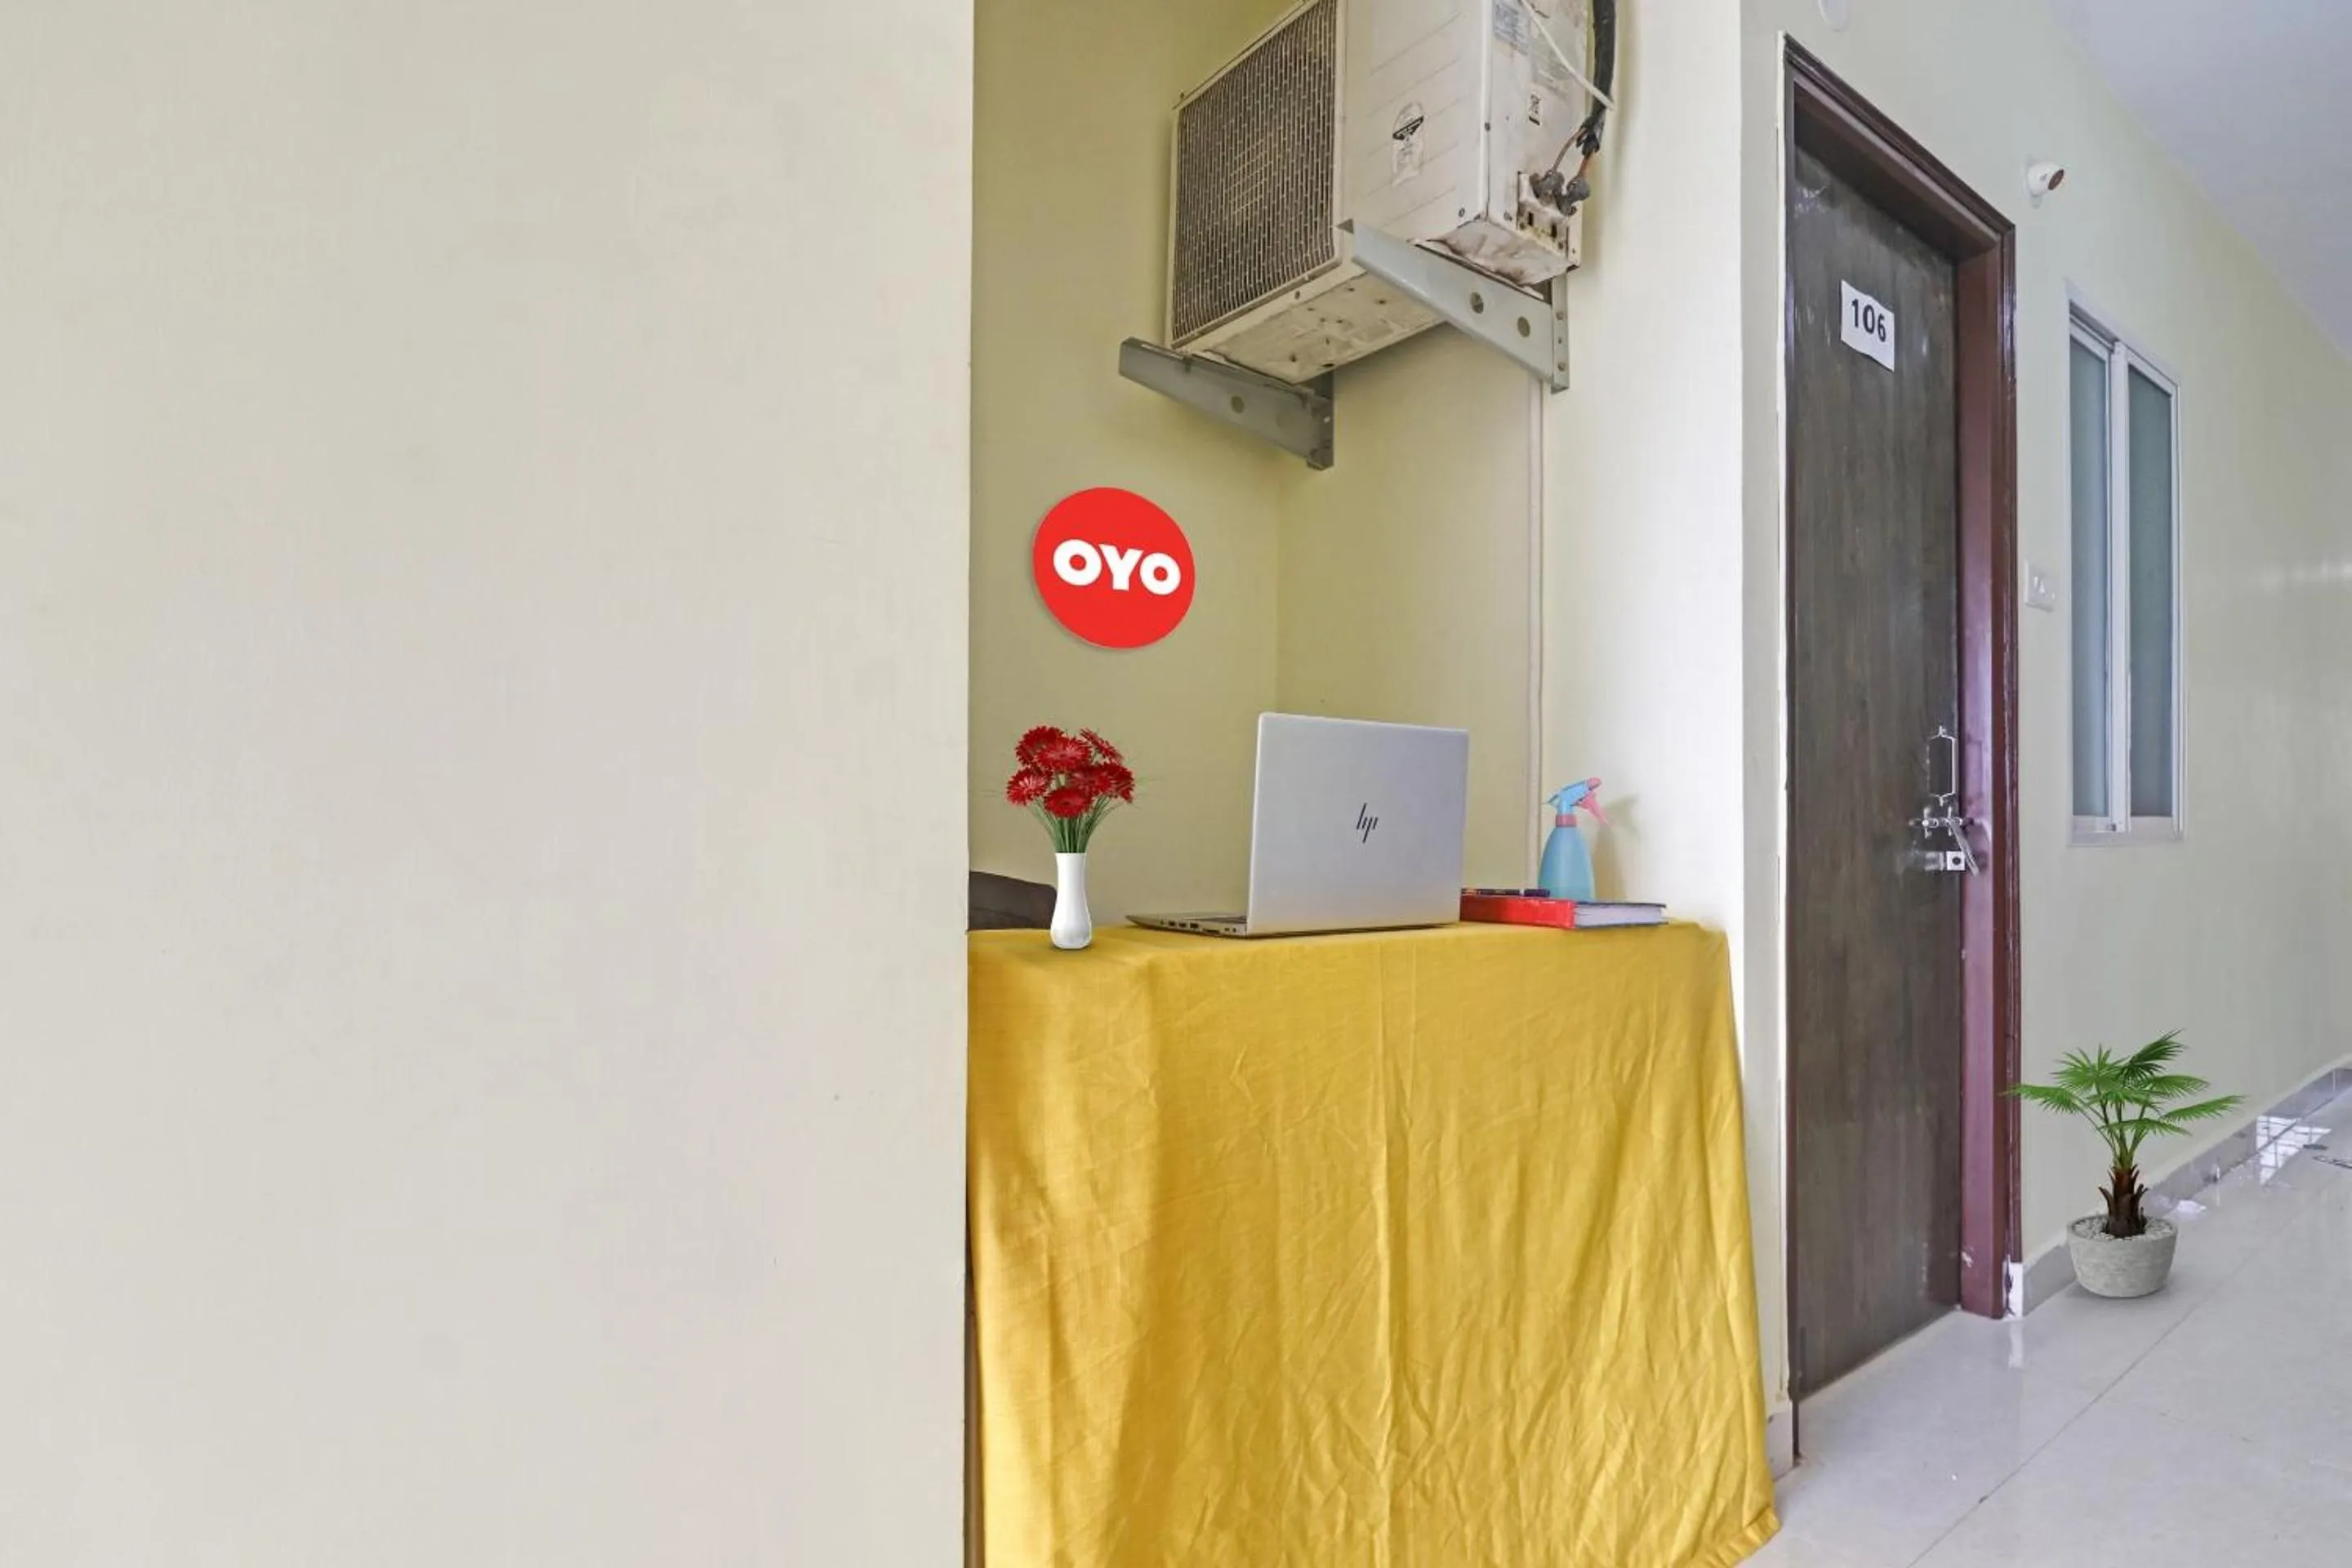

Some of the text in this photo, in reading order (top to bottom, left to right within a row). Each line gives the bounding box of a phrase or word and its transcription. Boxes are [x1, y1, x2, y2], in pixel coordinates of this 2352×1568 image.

[1851, 298, 1886, 342] 106
[1053, 539, 1181, 595] OYO
[1356, 802, 1379, 844] hp
